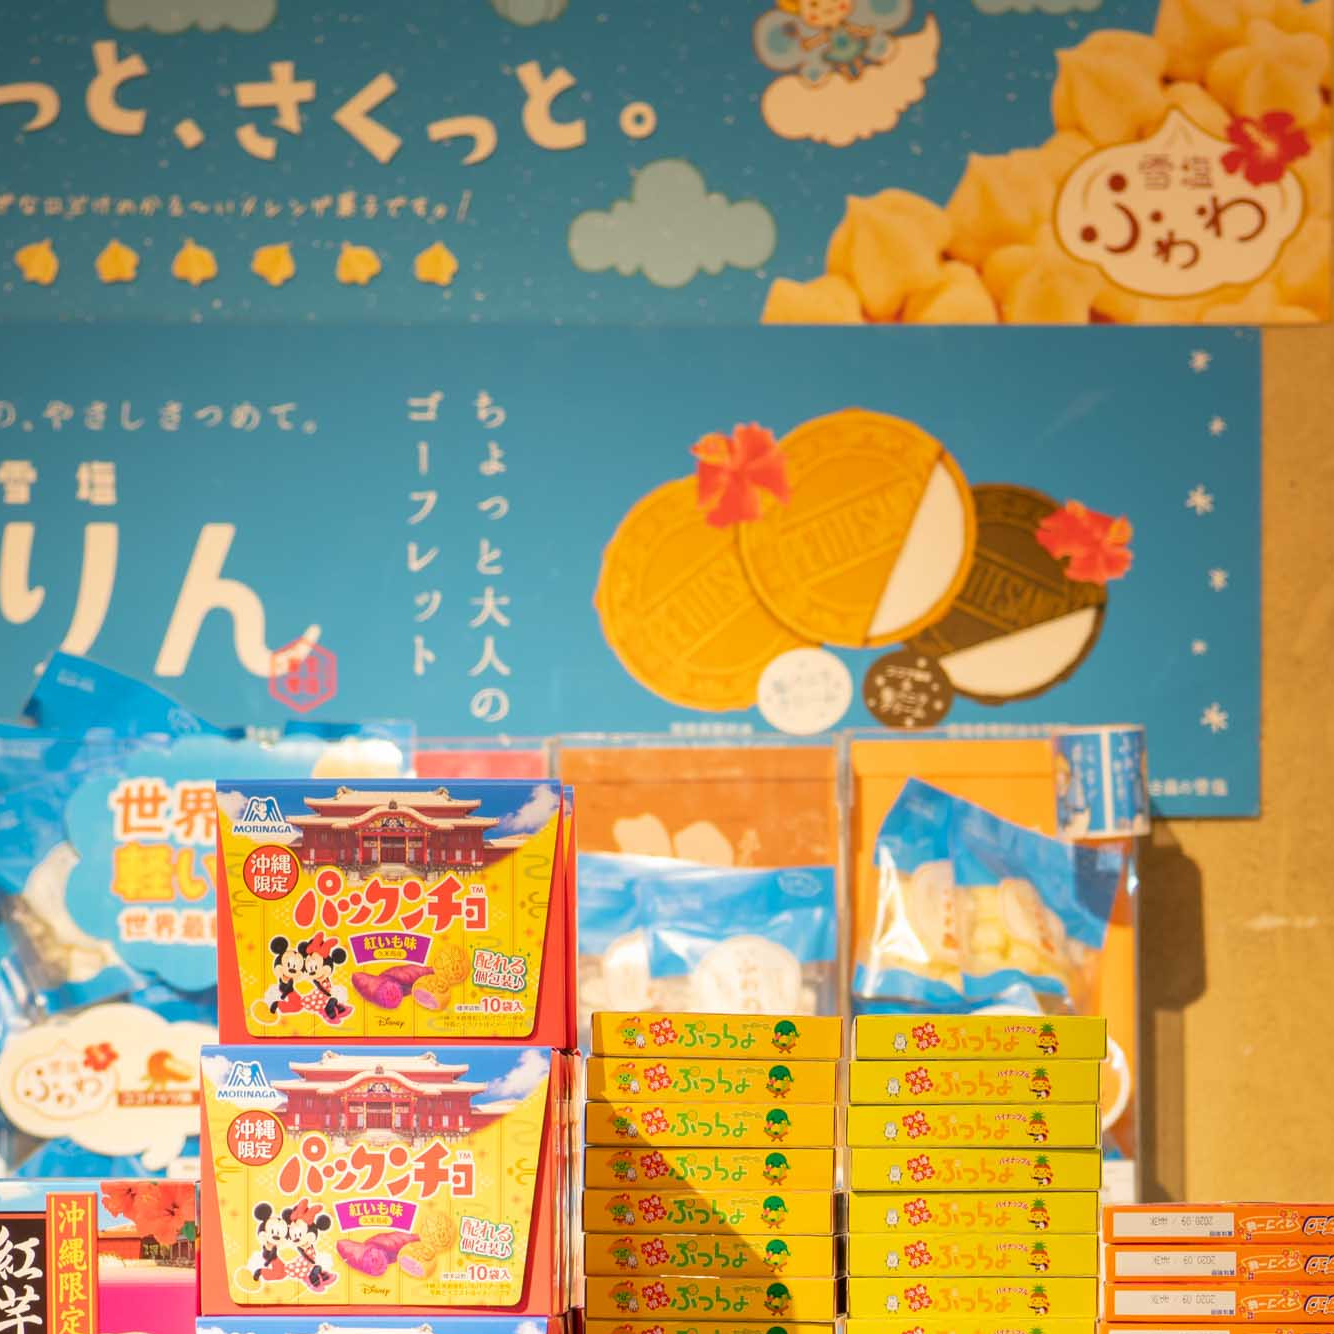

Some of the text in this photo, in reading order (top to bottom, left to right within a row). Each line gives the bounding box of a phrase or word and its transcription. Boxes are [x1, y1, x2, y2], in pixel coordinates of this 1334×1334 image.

[406, 392, 443, 676] ゴーフレット
[233, 824, 292, 833] MORINAGA
[251, 853, 292, 874] 沖縄
[254, 875, 288, 895] 限定
[294, 870, 488, 931] パックンチョ
[363, 936, 418, 951] 紅いも味
[677, 1021, 756, 1049] ぷっちょ
[217, 1090, 277, 1099] MORINAGA
[234, 1120, 277, 1140] 沖縄
[237, 1141, 273, 1159] 限定
[279, 1135, 474, 1198] パックンチョ
[348, 1202, 404, 1217] 紅いも味
